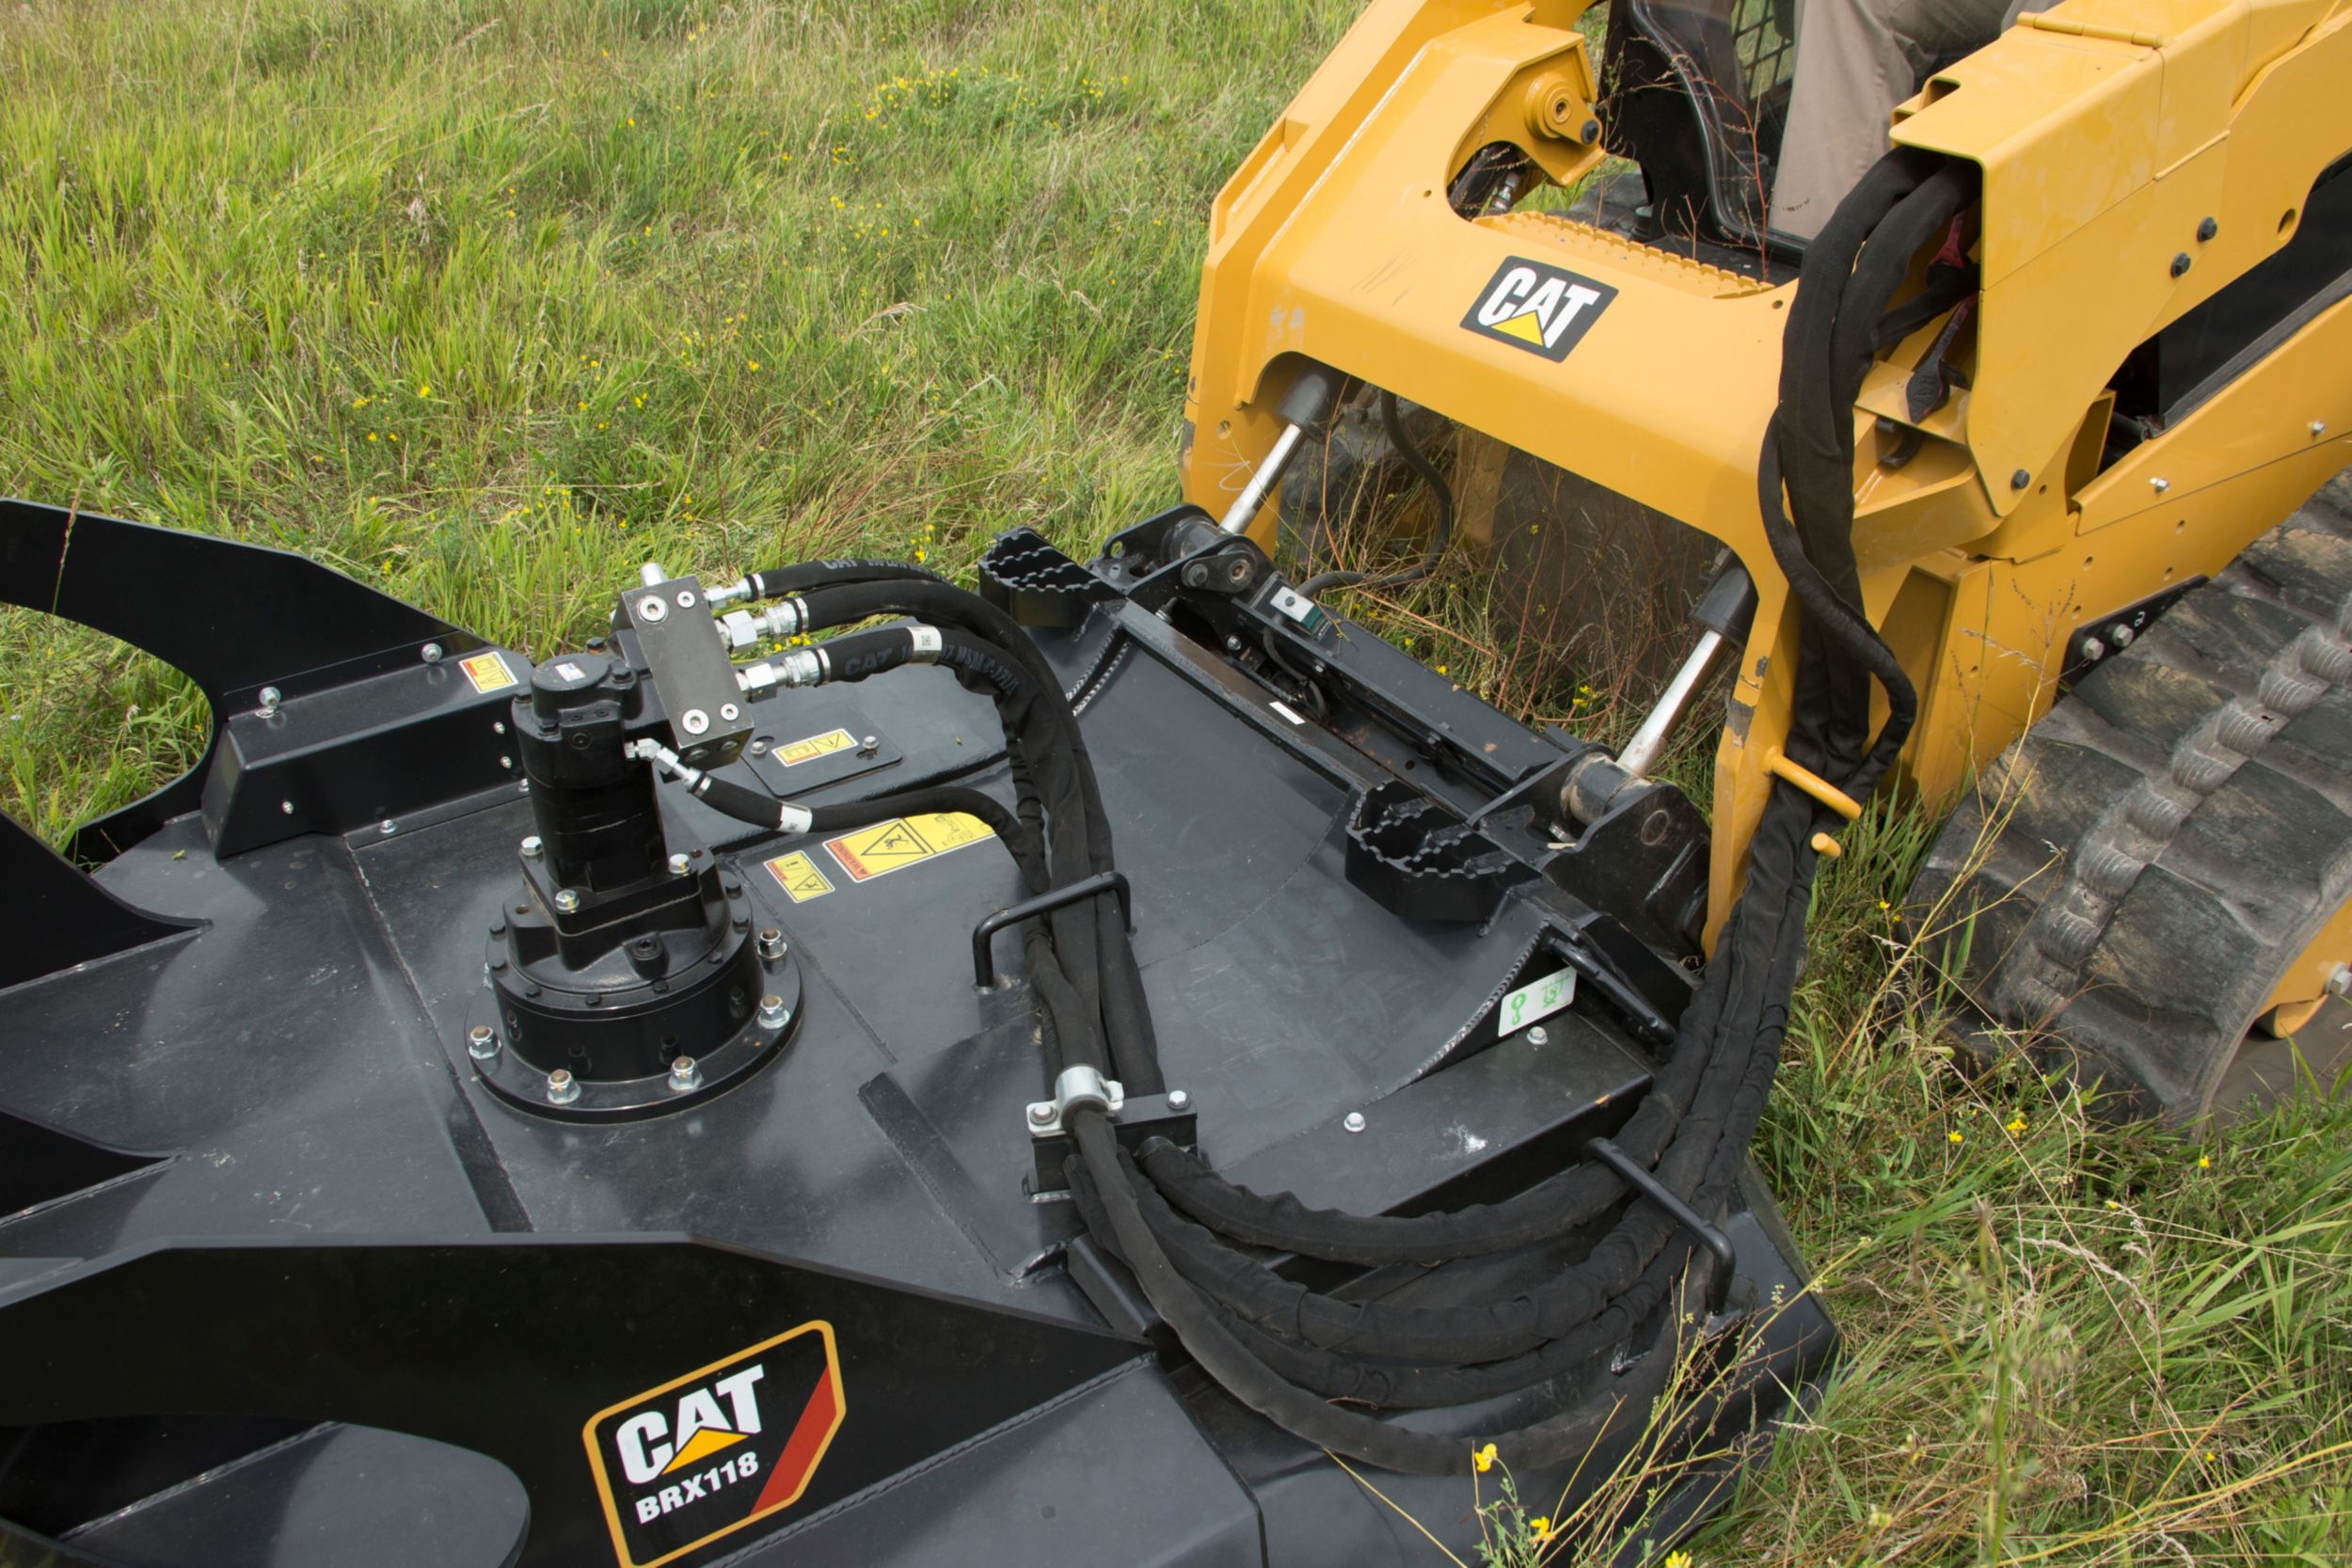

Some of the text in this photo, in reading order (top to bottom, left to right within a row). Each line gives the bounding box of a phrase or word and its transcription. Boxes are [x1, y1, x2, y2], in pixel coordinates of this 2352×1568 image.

[1478, 267, 1601, 349] CAT
[845, 649, 893, 675] CAT
[616, 1364, 764, 1484] CAT
[635, 1451, 759, 1524] BRX118
